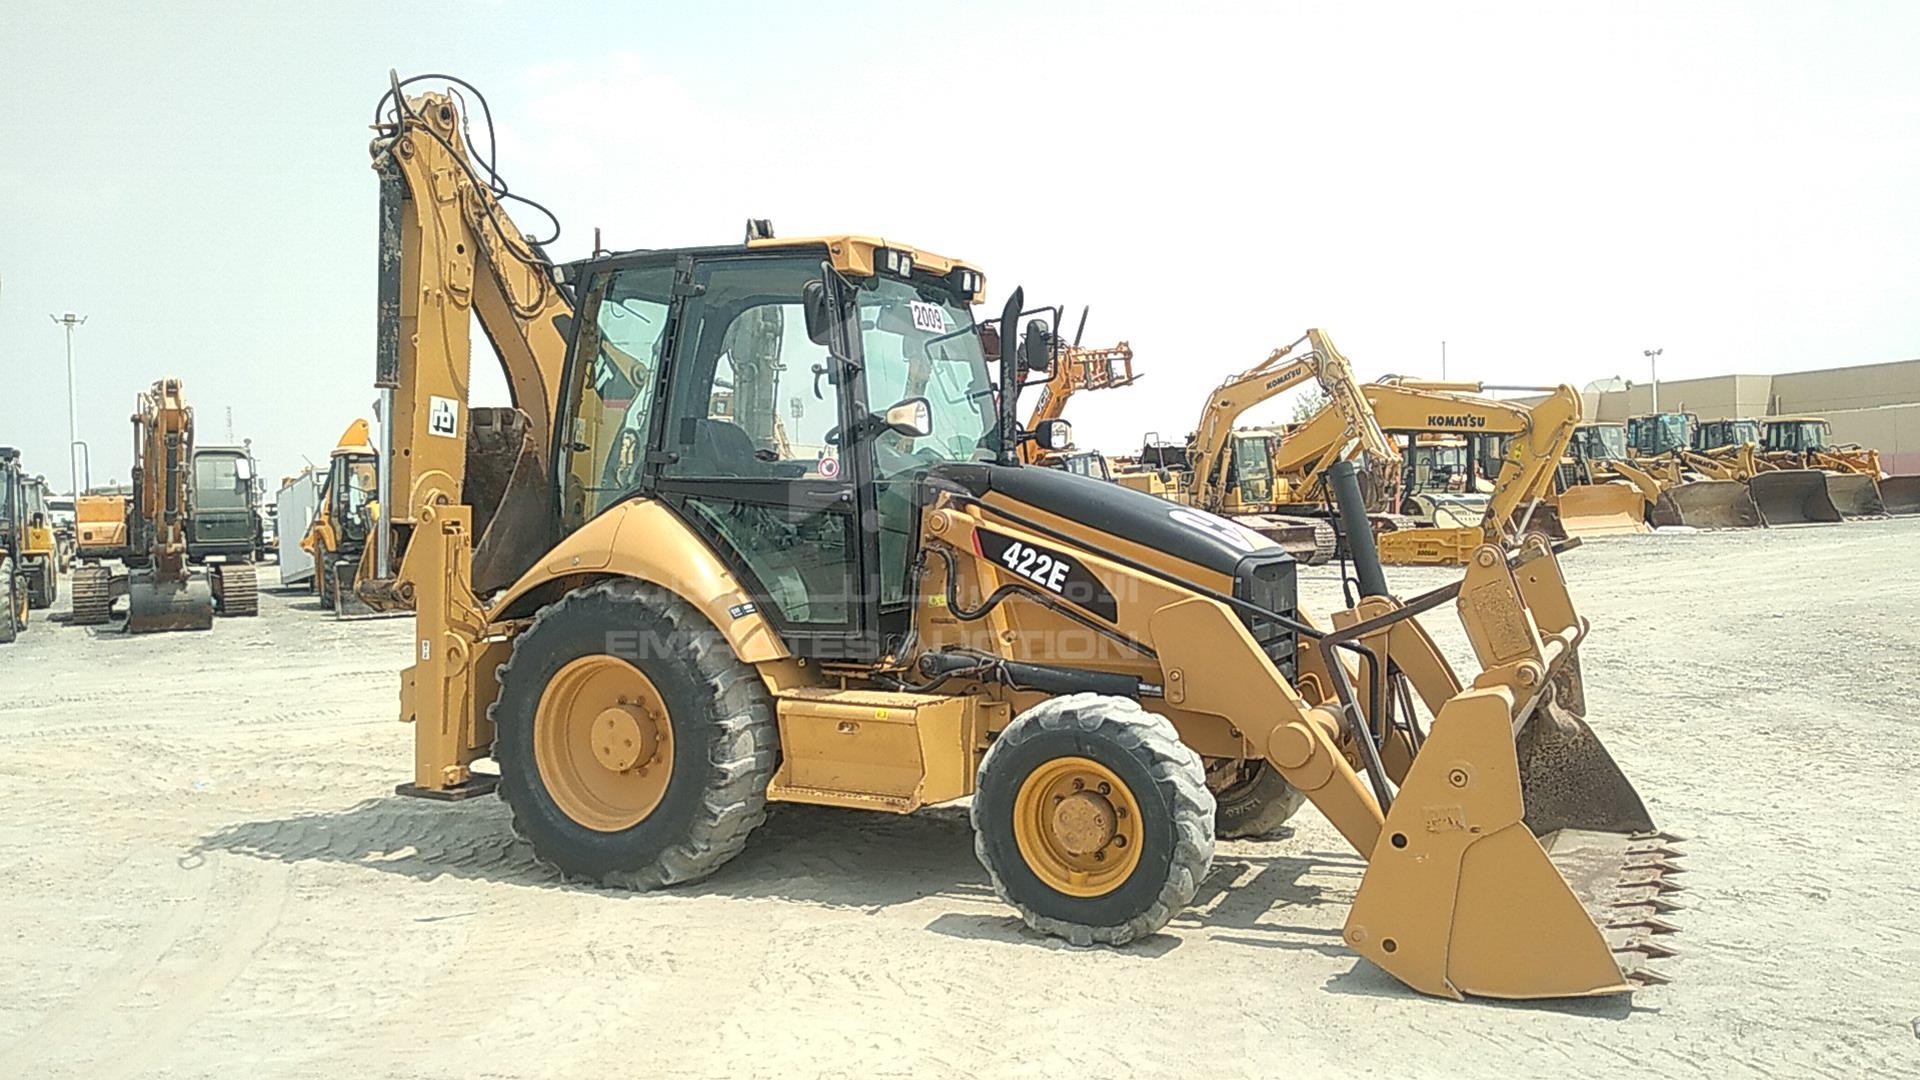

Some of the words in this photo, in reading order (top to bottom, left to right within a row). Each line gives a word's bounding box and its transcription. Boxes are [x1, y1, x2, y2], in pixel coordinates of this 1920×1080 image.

[914, 305, 943, 330] 2009
[1266, 367, 1302, 391] KOMATSU
[1427, 413, 1486, 428] KOMATSU
[1002, 541, 1071, 593] 422E
